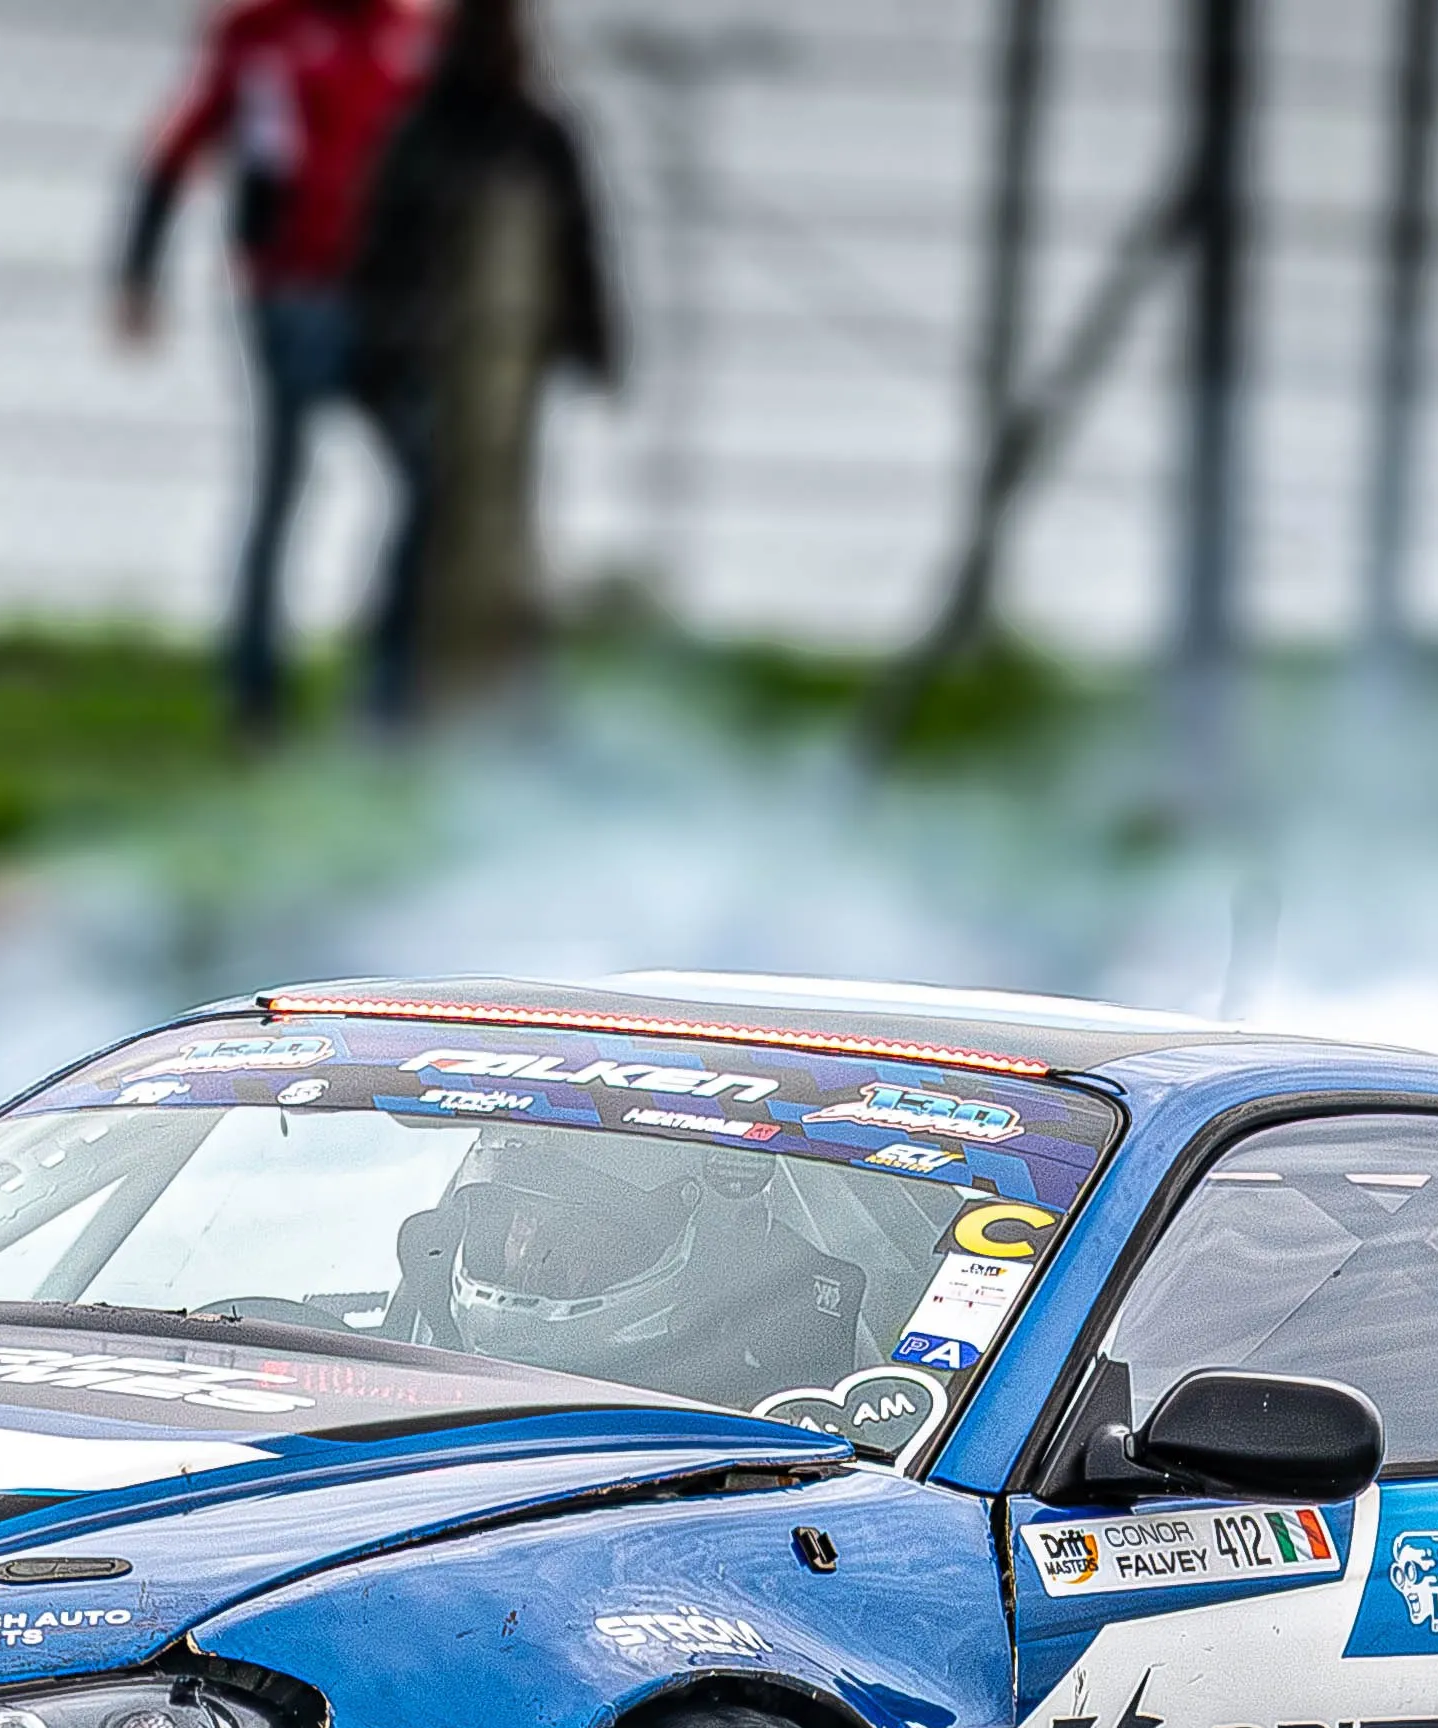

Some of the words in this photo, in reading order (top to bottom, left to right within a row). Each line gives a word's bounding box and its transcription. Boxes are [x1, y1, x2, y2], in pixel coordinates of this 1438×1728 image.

[397, 1049, 781, 1103] FALKEN
[953, 1203, 1056, 1258] C
[1040, 1528, 1094, 1558] Drift
[1104, 1521, 1196, 1548] CONOR
[1212, 1514, 1273, 1569] 412
[1044, 1556, 1099, 1576] MASTERS
[1115, 1549, 1208, 1577] FALVEY
[41, 1608, 133, 1628] AUTO
[594, 1605, 774, 1653] STRÖM
